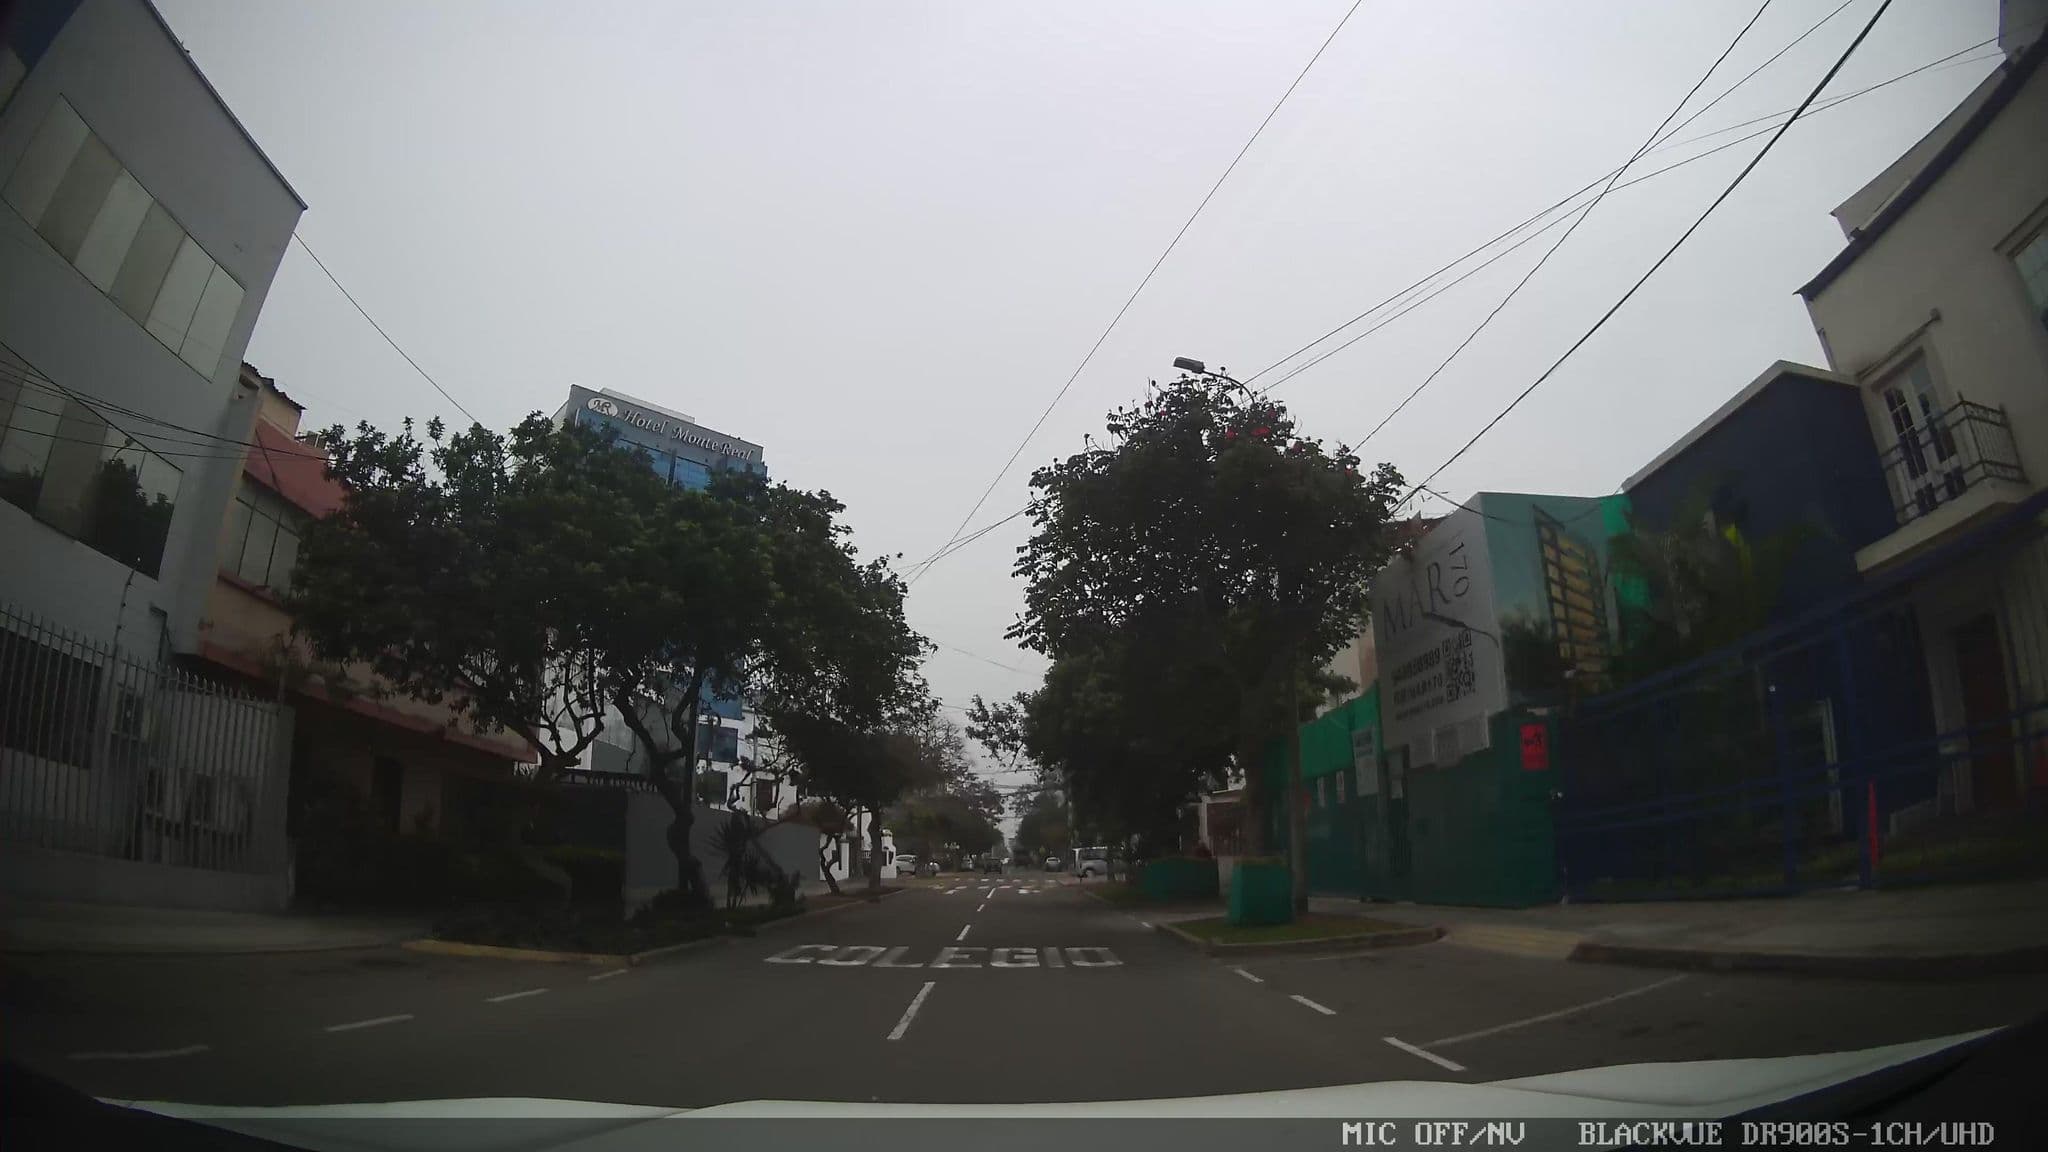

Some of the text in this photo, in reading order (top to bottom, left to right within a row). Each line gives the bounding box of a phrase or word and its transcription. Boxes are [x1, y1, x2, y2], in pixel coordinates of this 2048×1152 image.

[624, 409, 754, 461] Hotel Monte Real
[1384, 561, 1449, 641] MAR
[764, 945, 1124, 968] COLEGIO
